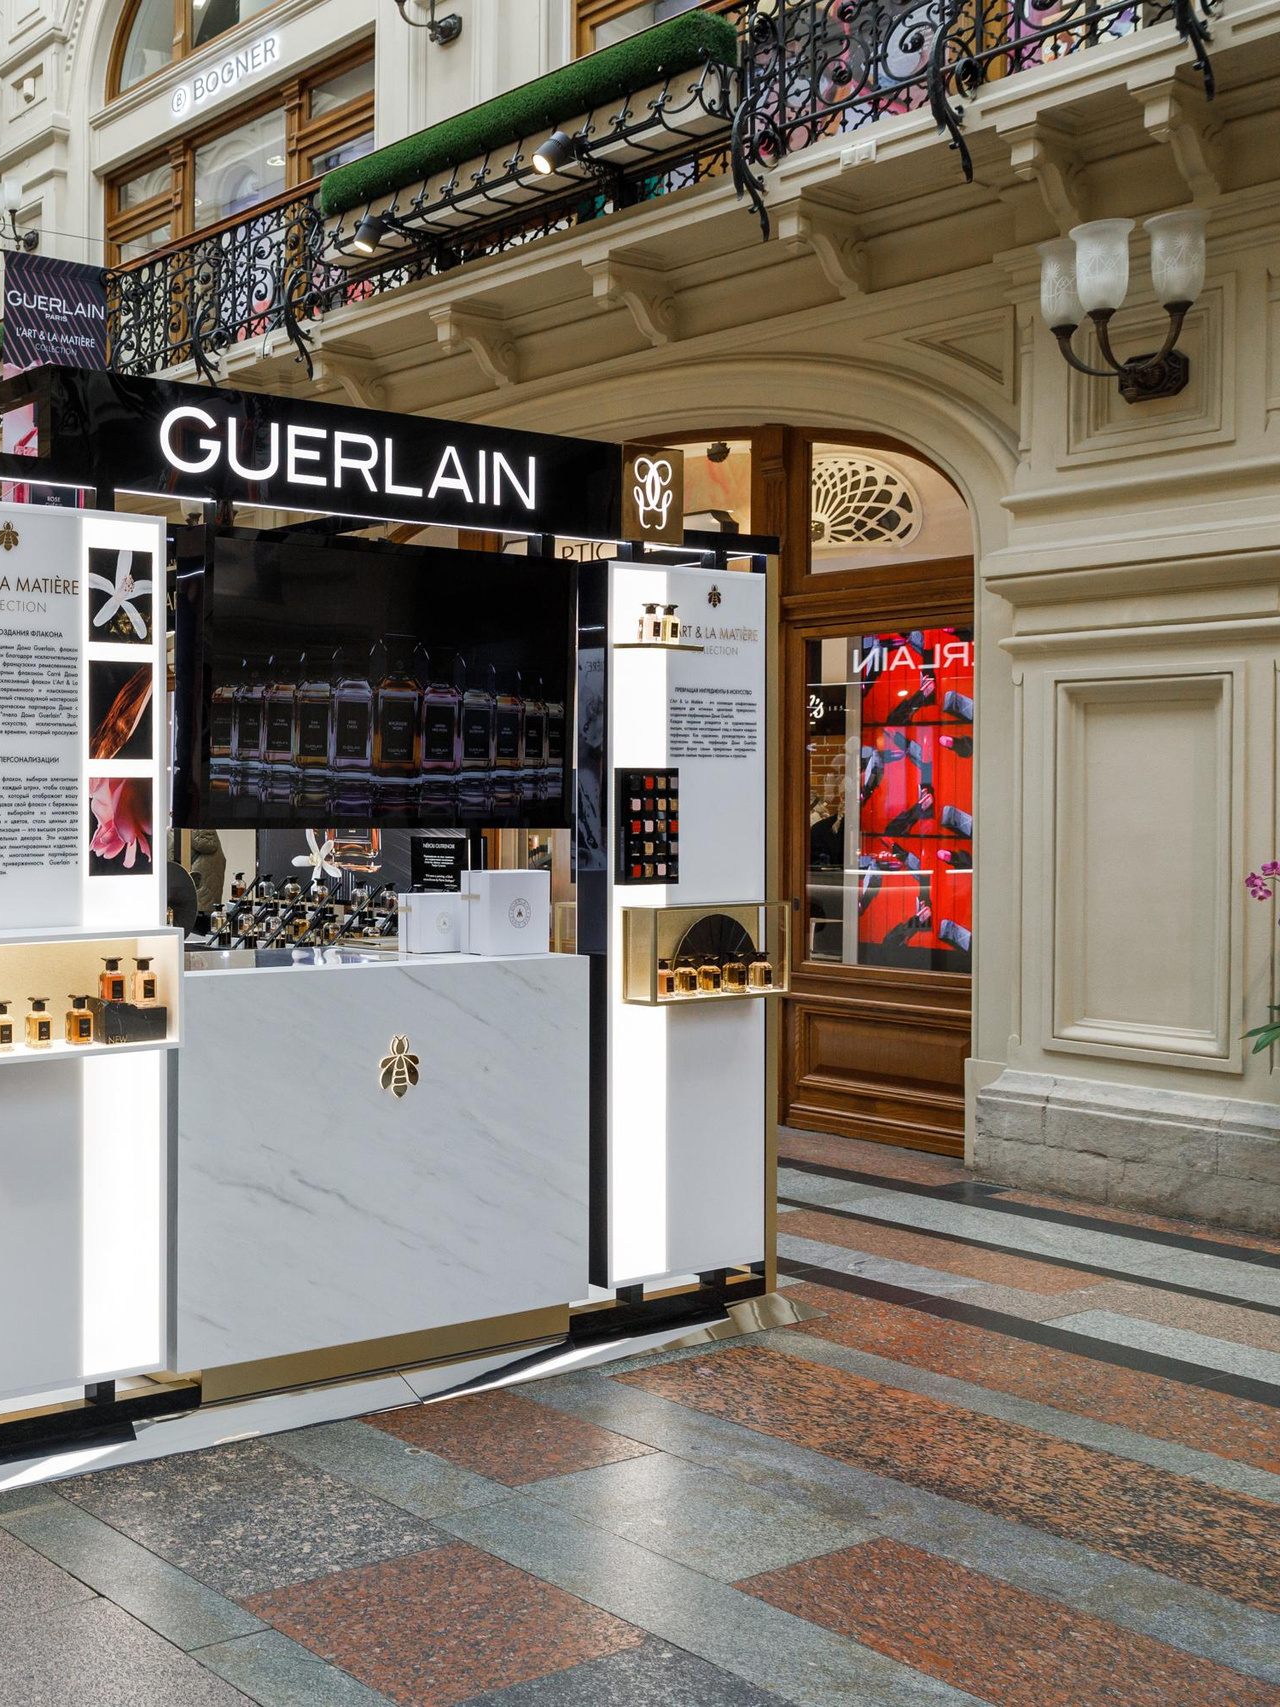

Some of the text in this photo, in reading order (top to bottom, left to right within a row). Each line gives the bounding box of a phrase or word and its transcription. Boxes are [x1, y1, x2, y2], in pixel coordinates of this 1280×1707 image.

[193, 38, 276, 101] BOGNER
[7, 290, 104, 320] GUERLAIN
[45, 313, 68, 322] PARIS
[16, 327, 95, 348] L'ART & LA MATIÈRE
[35, 343, 77, 356] COLLECTION
[159, 406, 536, 510] GUERLAIN
[16, 575, 79, 595] MATIÈRE
[679, 626, 758, 642] ART & LA MATIÈRE
[694, 645, 738, 656] LLECTION
